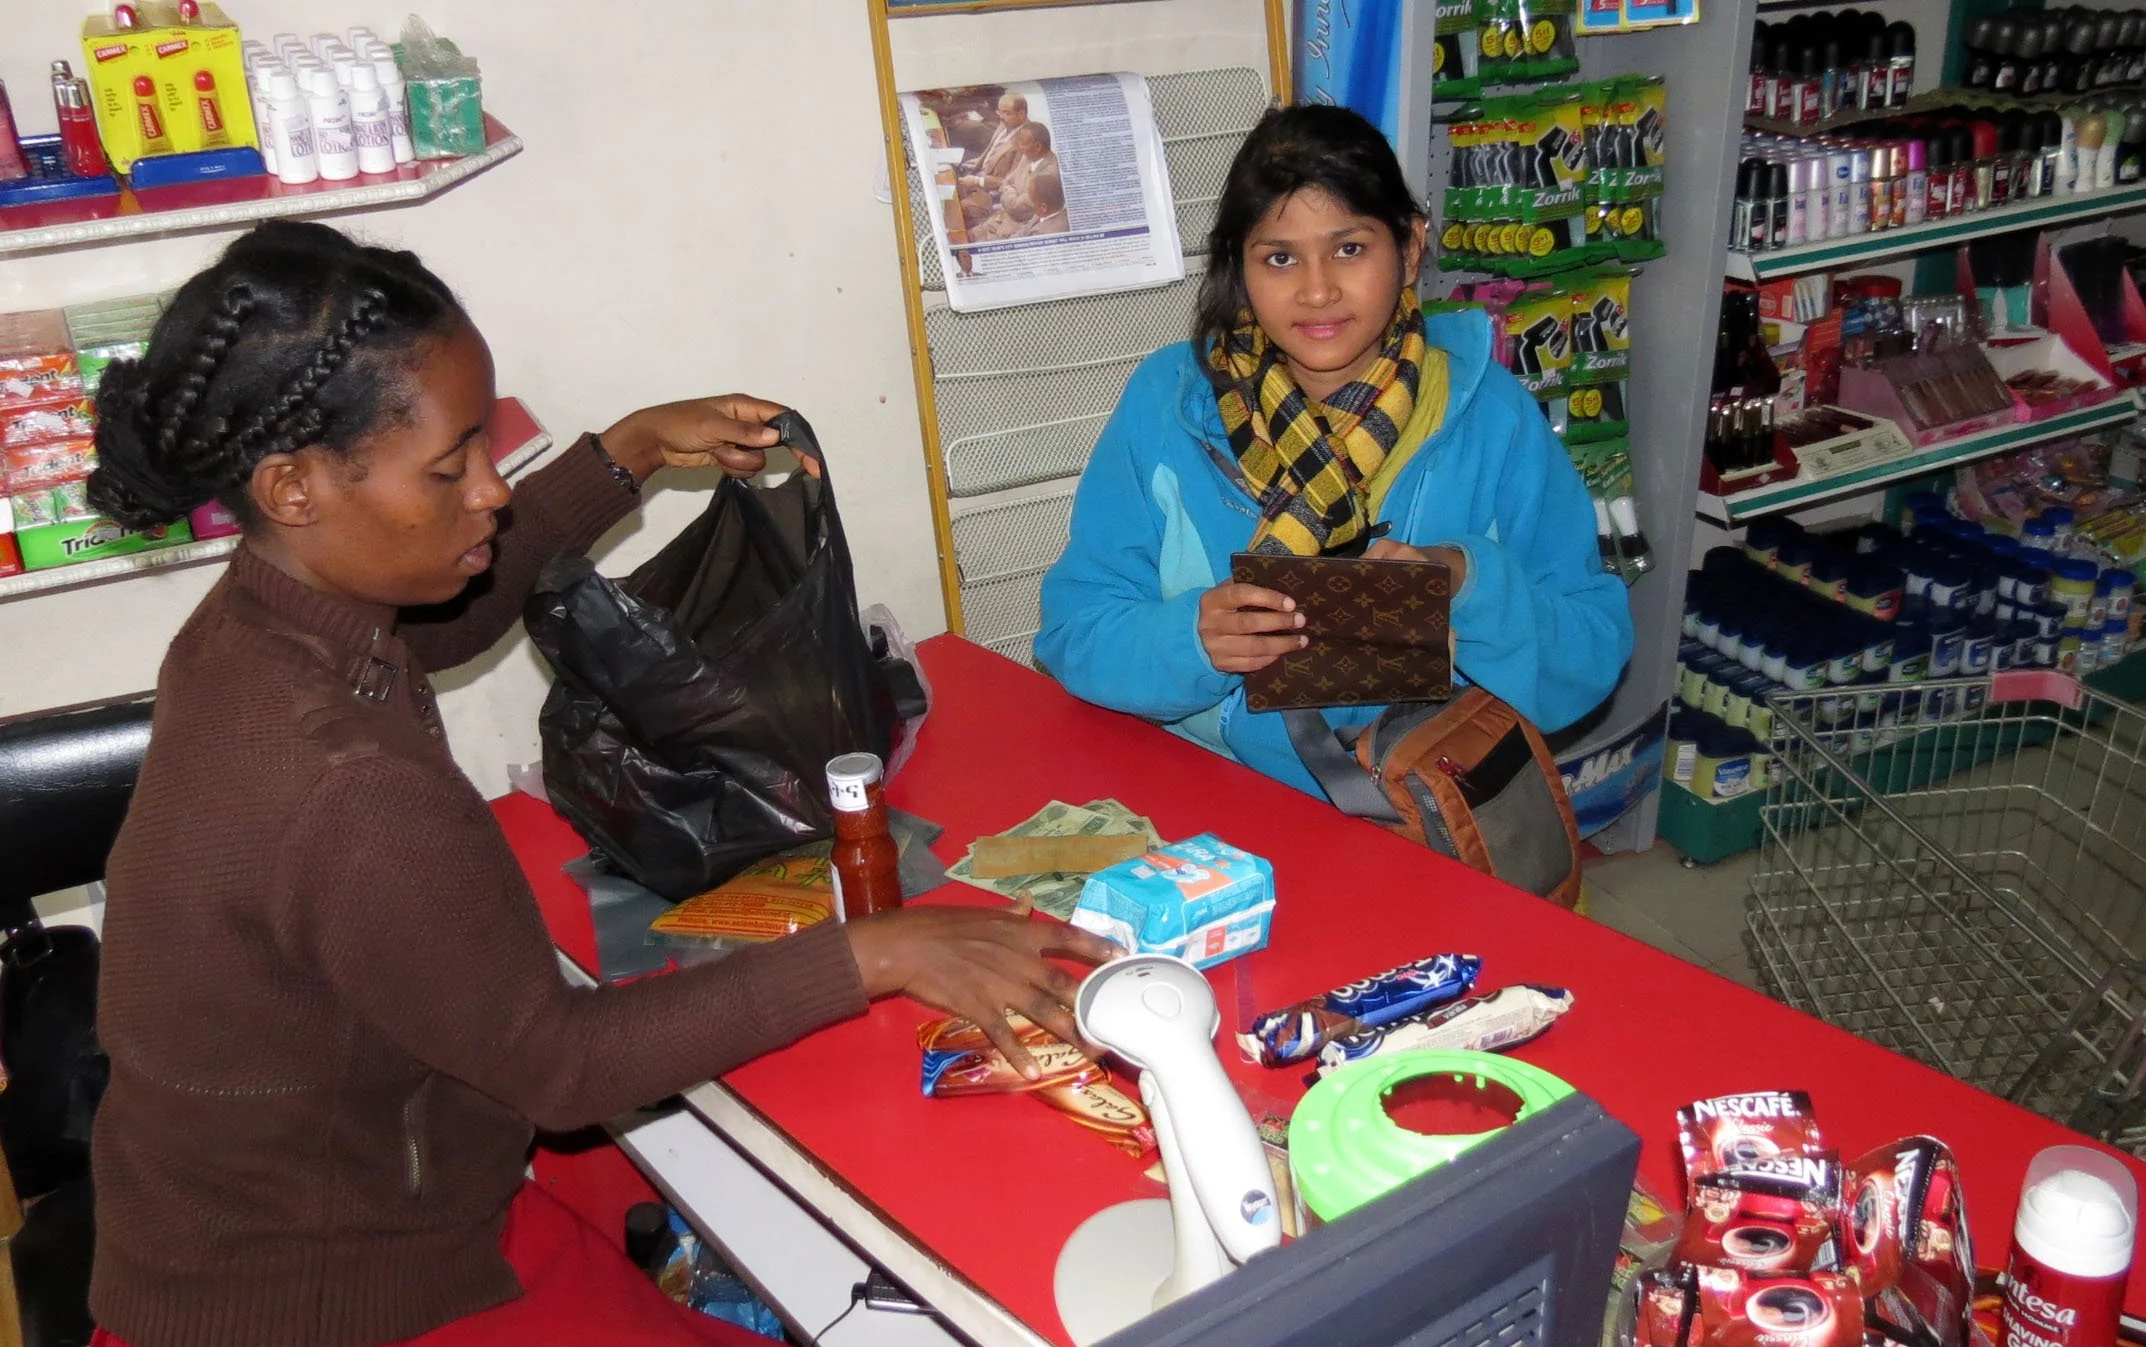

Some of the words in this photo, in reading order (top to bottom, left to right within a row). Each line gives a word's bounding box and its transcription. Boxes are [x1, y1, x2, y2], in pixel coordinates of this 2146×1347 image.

[1532, 189, 1581, 208] Zorrik
[1693, 1092, 1796, 1122] NESCAFÉ
[2007, 1275, 2077, 1326] ntesa
